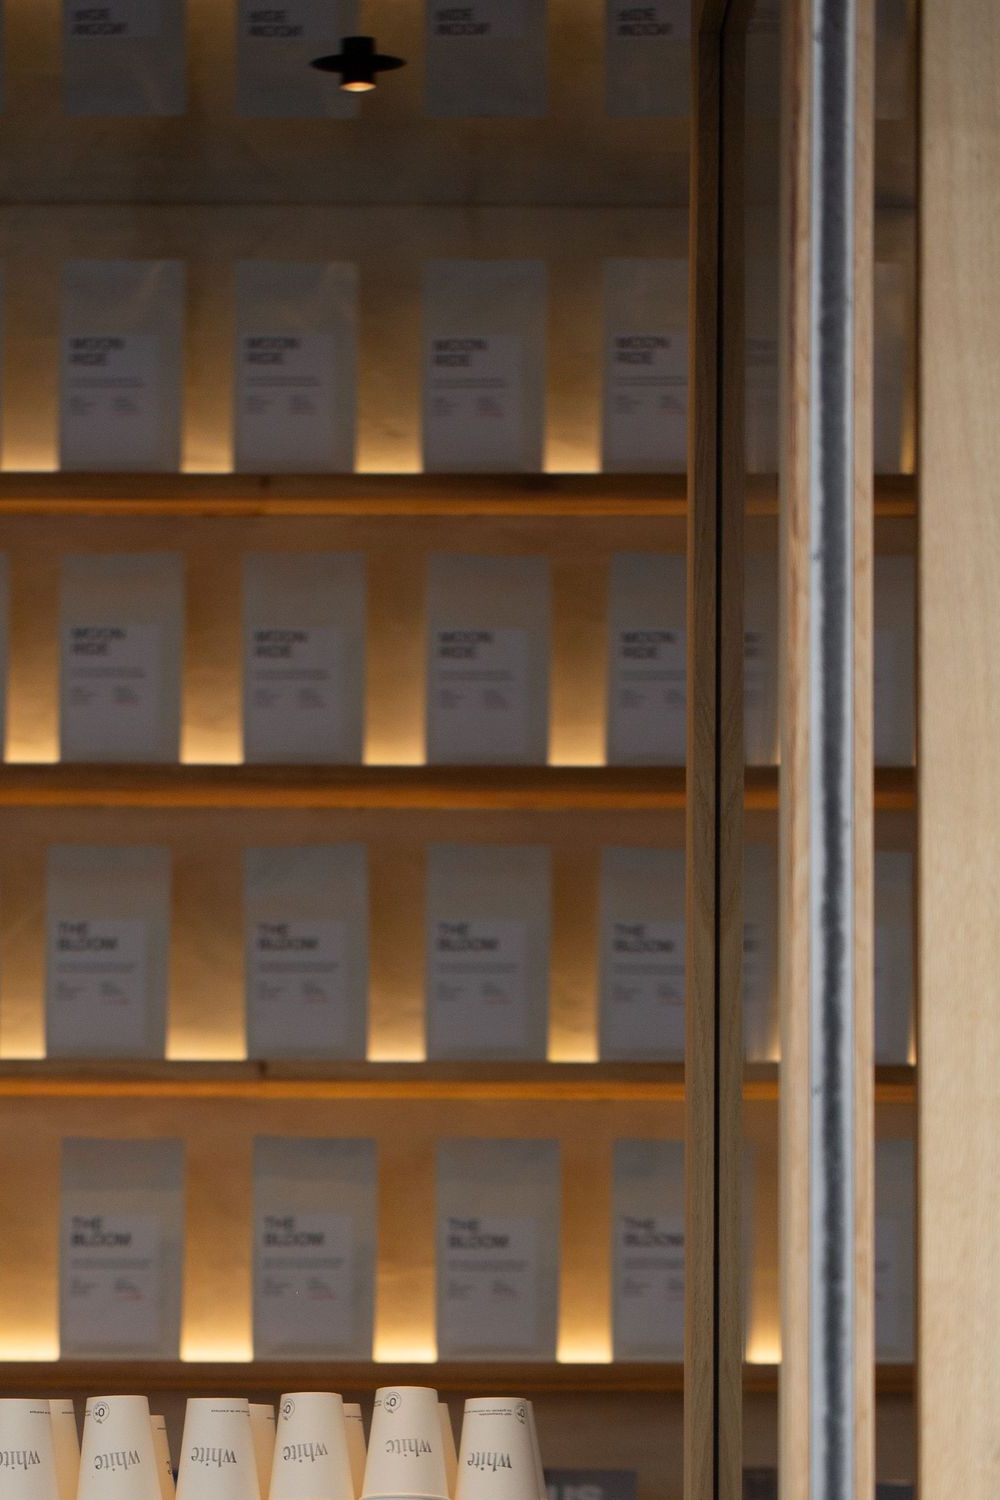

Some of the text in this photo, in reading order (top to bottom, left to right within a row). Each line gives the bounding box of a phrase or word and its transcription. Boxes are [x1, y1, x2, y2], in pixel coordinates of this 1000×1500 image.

[70, 1231, 132, 1247] BLOOM
[263, 1233, 325, 1247] BLOOM
[447, 1233, 510, 1249] BLOOM
[190, 1446, 238, 1468] white
[283, 1440, 329, 1463] white
[385, 1438, 433, 1457] white
[94, 1449, 141, 1472] white
[466, 1451, 513, 1472] white
